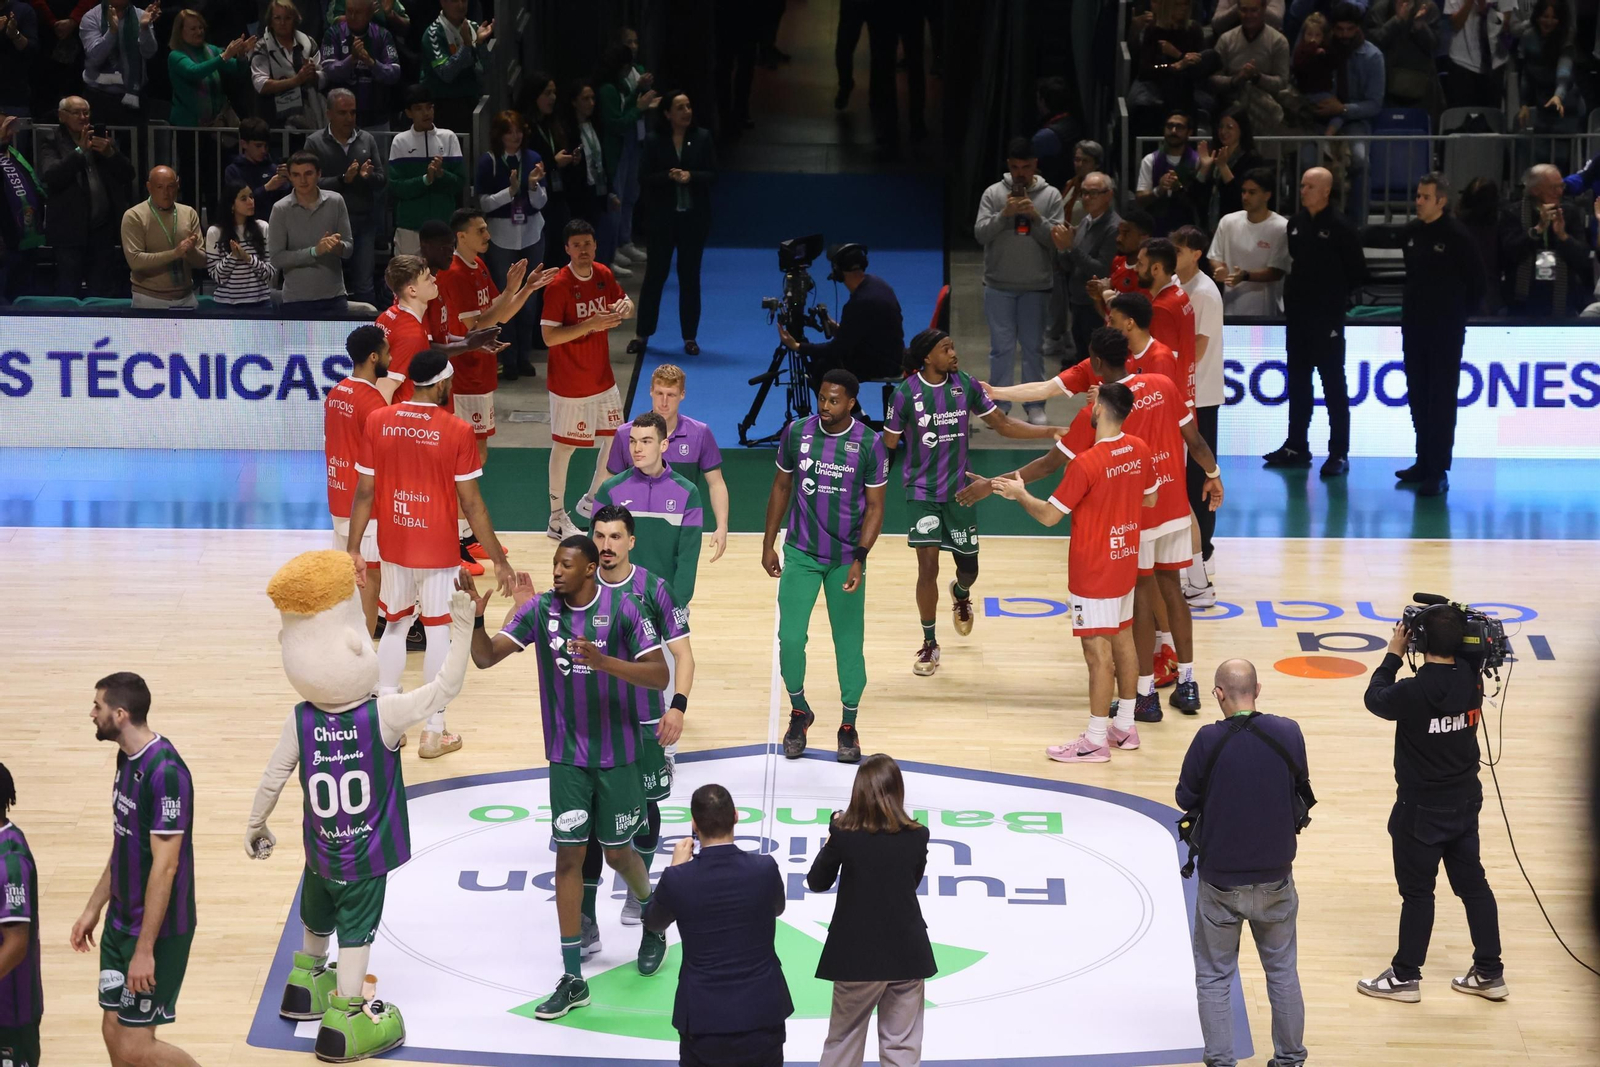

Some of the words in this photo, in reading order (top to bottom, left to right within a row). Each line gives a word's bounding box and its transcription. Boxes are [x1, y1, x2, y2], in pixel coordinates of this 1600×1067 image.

[47, 336, 353, 401] TÉCNICAS
[1223, 360, 1600, 408] SOUCONES
[933, 409, 967, 420] Fundación
[934, 418, 958, 426] Unicaja
[382, 423, 440, 441] inmoovs
[814, 467, 843, 479] Unicaja
[815, 460, 855, 473] Fundación
[393, 489, 430, 503] Adbisio
[394, 500, 410, 515] ETL
[393, 514, 428, 529] GLOBAL
[314, 725, 358, 742] Chicui
[308, 770, 371, 818] 00
[320, 820, 374, 839] Andalucía
